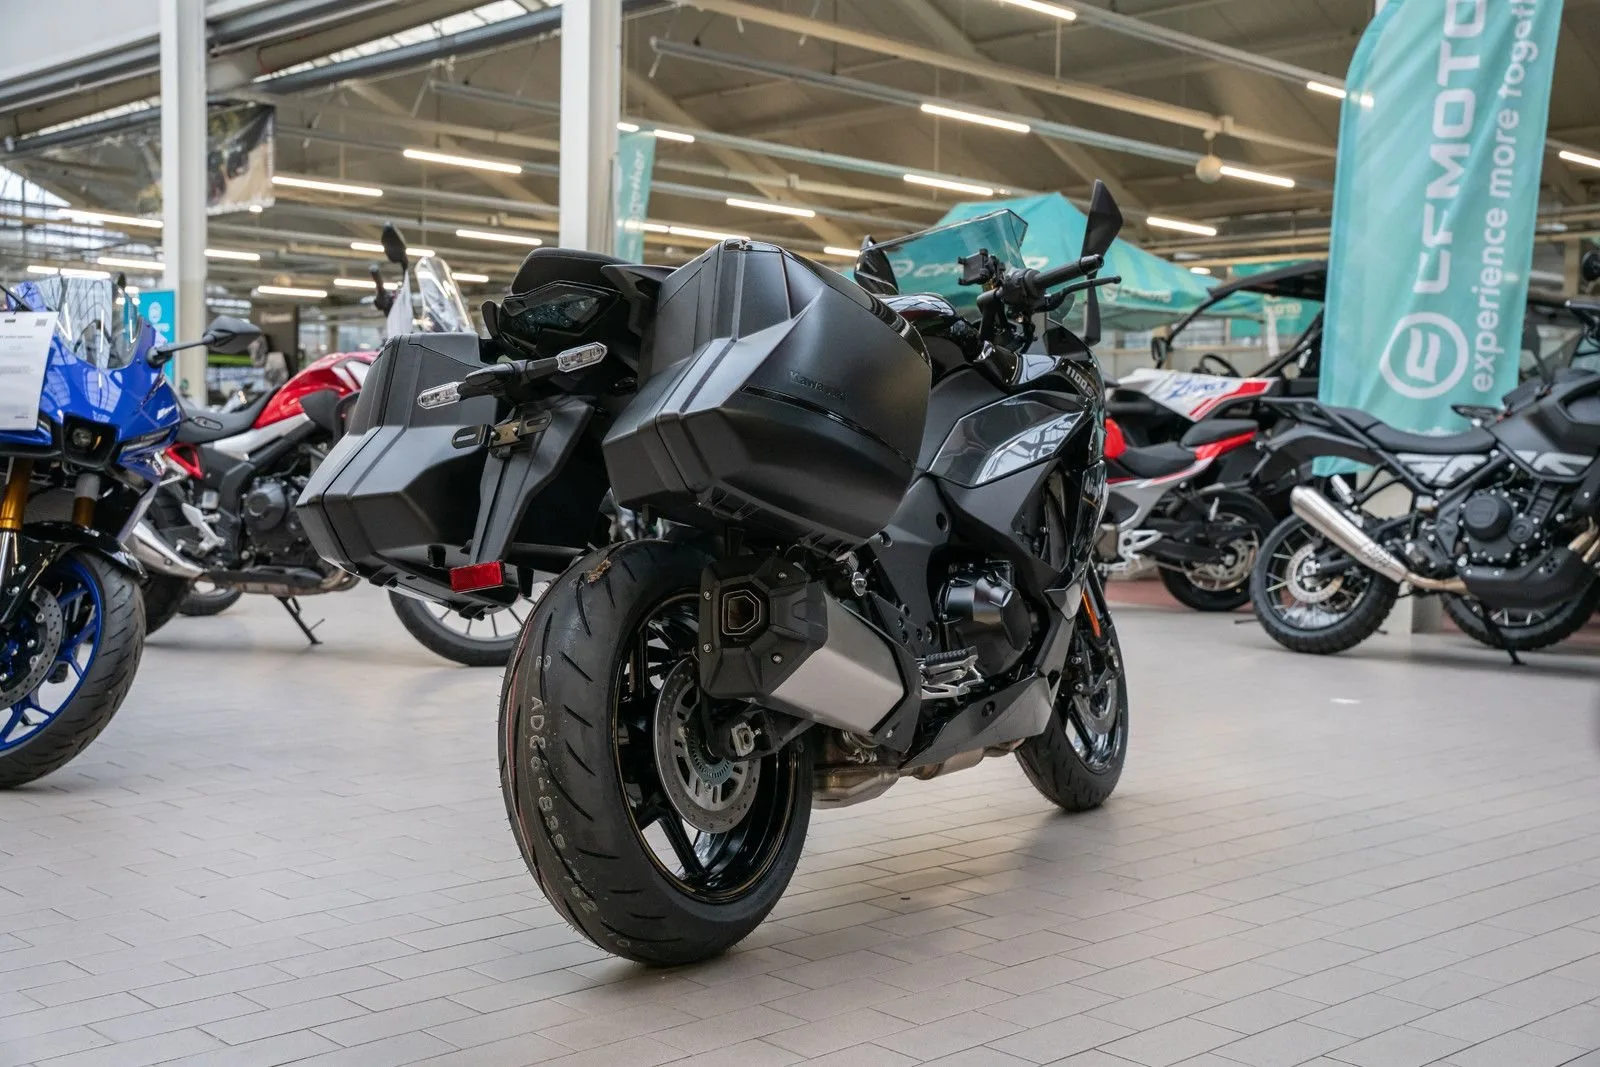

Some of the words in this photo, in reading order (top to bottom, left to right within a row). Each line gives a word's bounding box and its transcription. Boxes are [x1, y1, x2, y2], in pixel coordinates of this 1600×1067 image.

[1413, 0, 1487, 293] CFMOTO
[1489, 108, 1520, 198] more
[1471, 207, 1508, 393] experience
